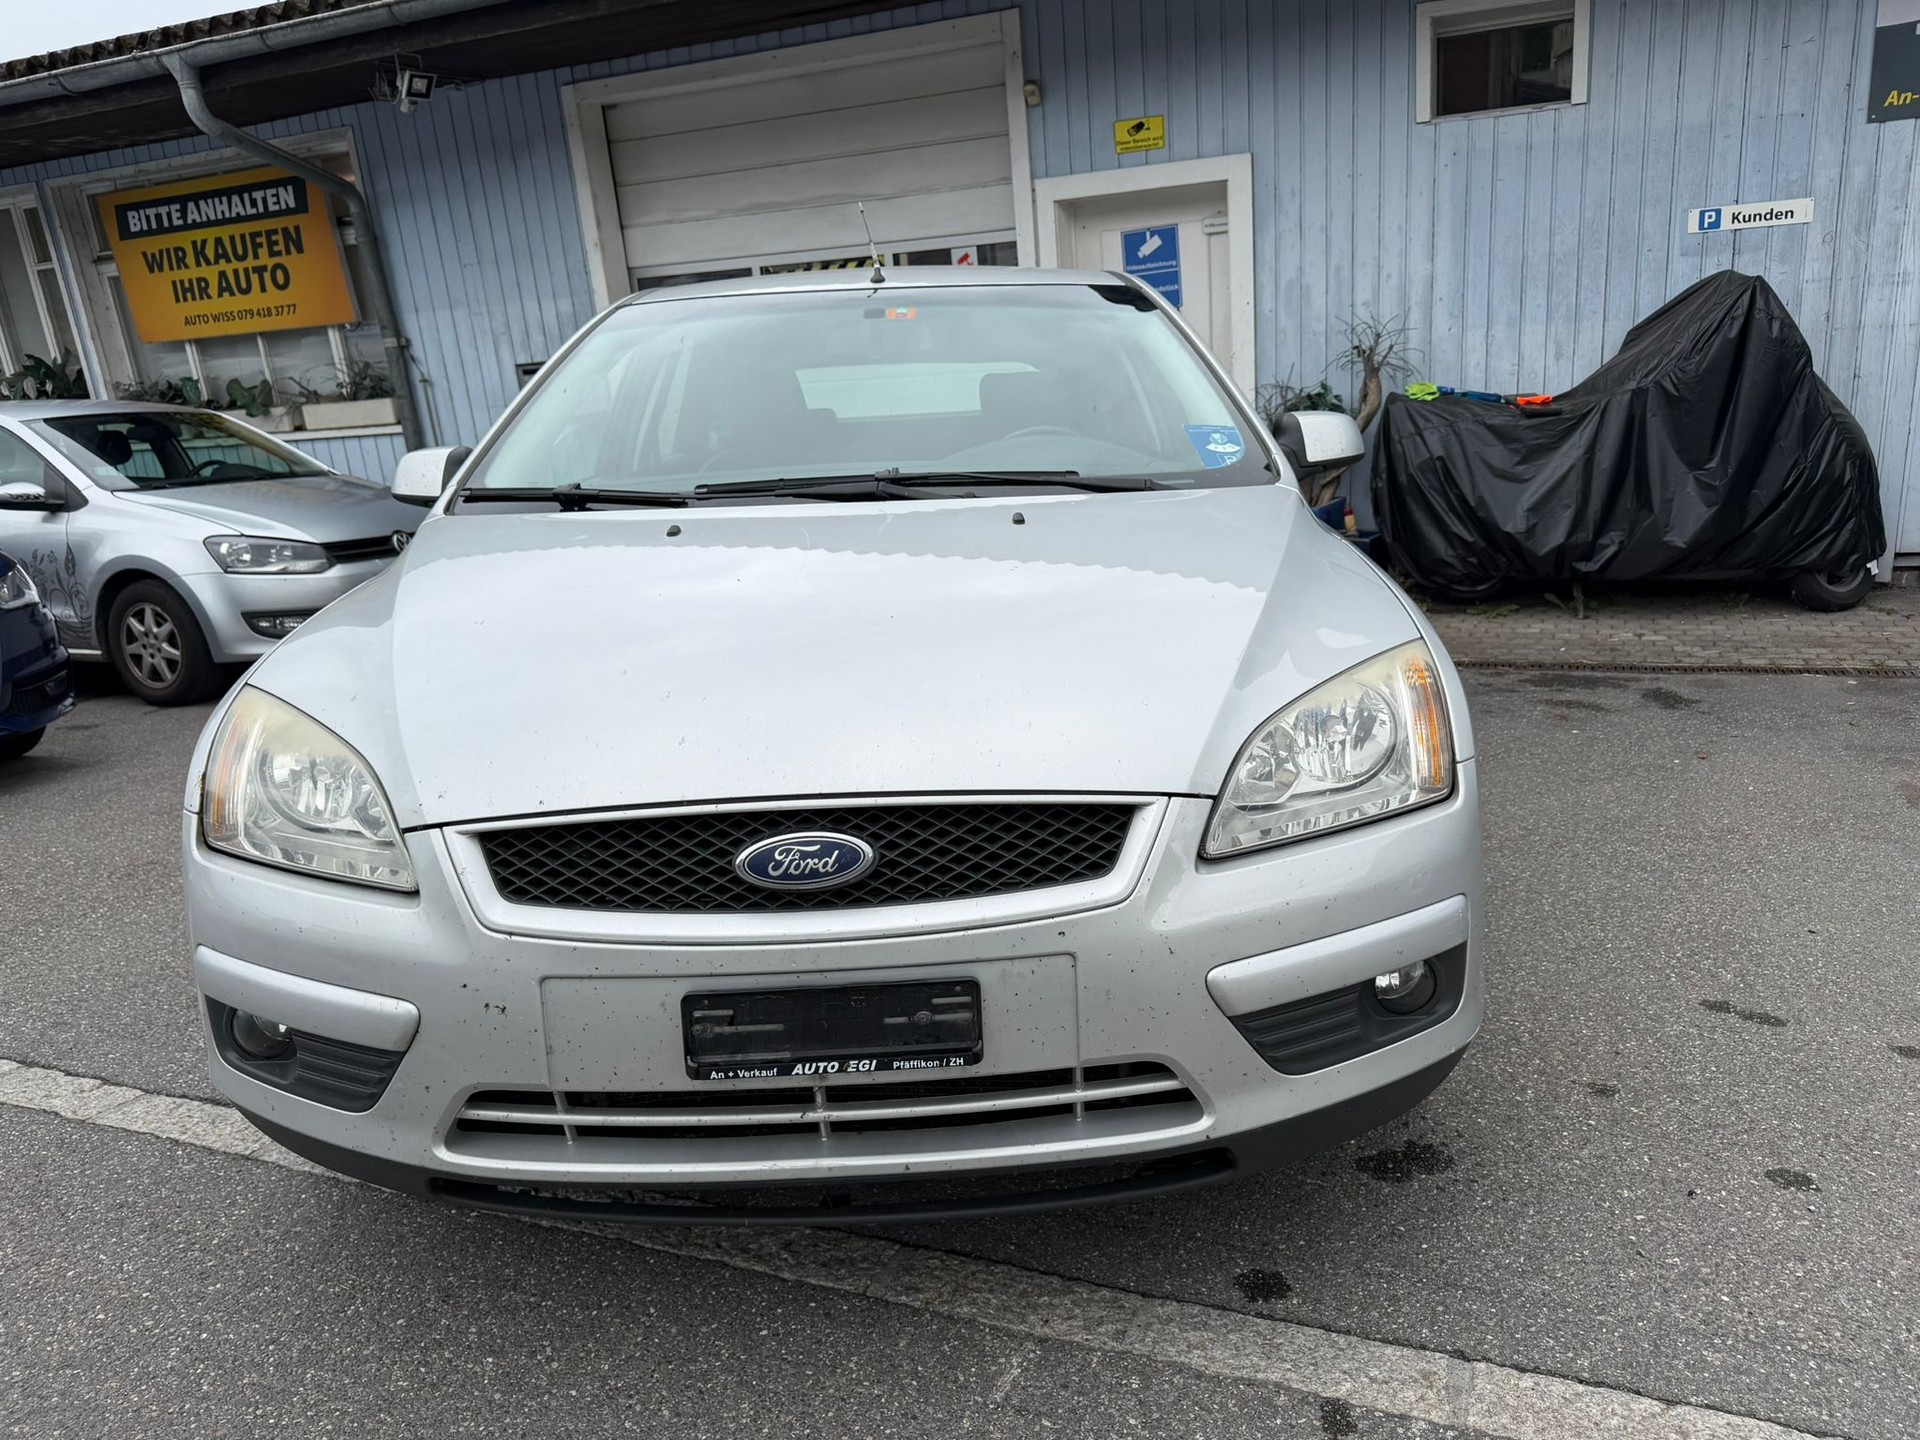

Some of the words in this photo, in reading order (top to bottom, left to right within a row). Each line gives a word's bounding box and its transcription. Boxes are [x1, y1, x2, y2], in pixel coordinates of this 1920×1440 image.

[126, 204, 184, 234] BITTE
[186, 184, 296, 225] ANHALTEN
[1731, 207, 1795, 225] Kunden
[141, 246, 190, 275] WIR
[190, 224, 305, 268] KAUFEN
[171, 276, 213, 304] IHR
[216, 262, 291, 299] AUTO
[184, 313, 210, 328] AUTO
[211, 310, 236, 324] WISS
[237, 308, 255, 321] 079
[256, 306, 273, 319] 418
[768, 844, 839, 877] Ford
[710, 1070, 725, 1079] An
[737, 1067, 778, 1079] Verkauf
[792, 1061, 839, 1075] AUTO
[847, 1060, 878, 1072] EGI
[893, 1059, 940, 1070] Pfäffikon
[949, 1057, 964, 1067] ZH
